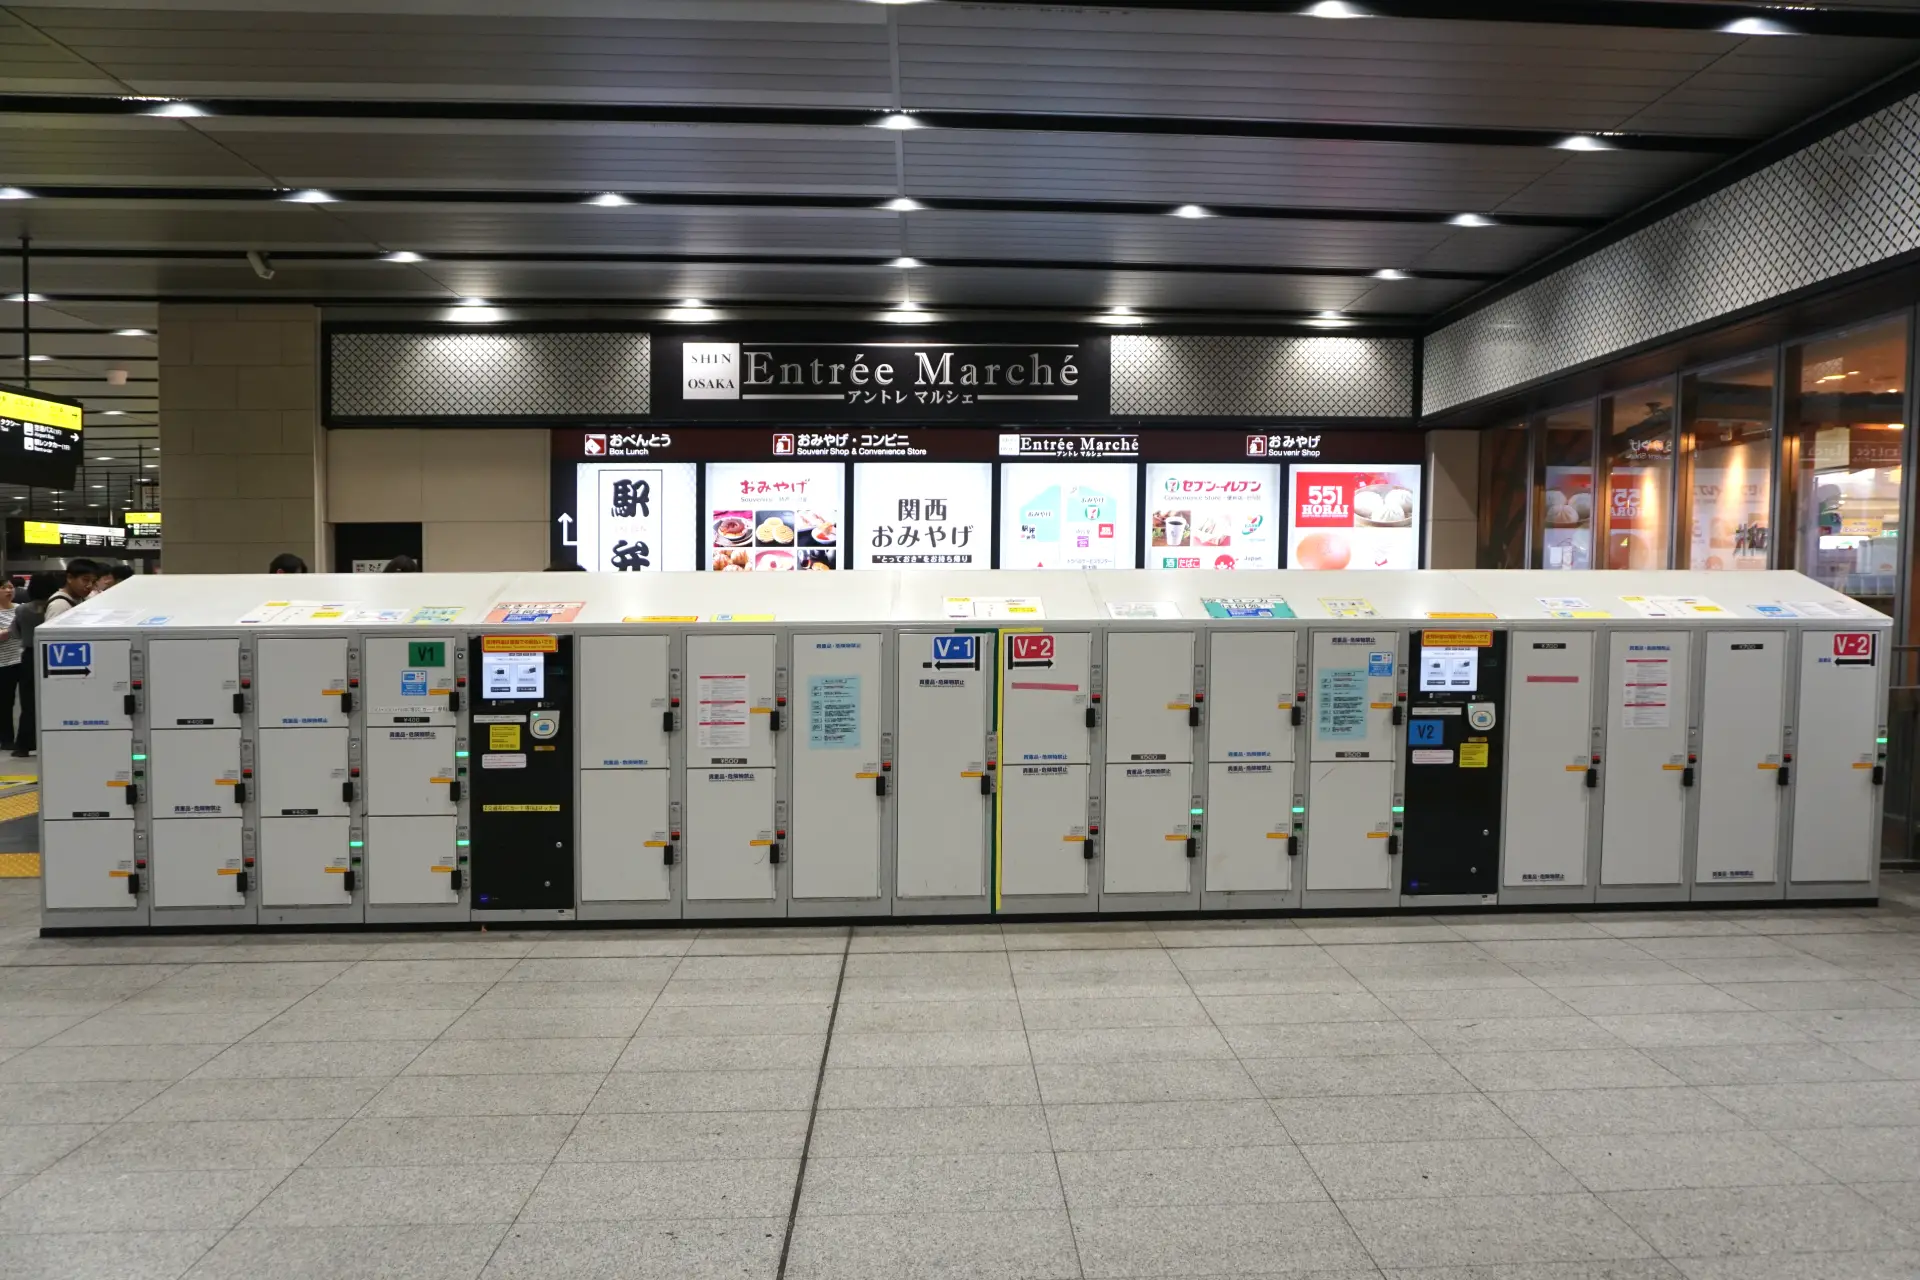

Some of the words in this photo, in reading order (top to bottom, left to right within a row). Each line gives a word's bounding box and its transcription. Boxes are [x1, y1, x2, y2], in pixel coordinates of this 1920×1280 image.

[690, 353, 731, 364] SHIN
[743, 351, 894, 386] Entrée
[914, 351, 1079, 386] Marché
[688, 378, 735, 389] OSAKA
[847, 389, 908, 404] アントレ
[914, 389, 974, 404] マルシェ
[609, 433, 672, 447] おべんとう
[1020, 437, 1074, 450] Entrée
[1080, 437, 1139, 450] Marché
[1269, 434, 1322, 448] おみやげ
[609, 447, 625, 455] Box
[625, 447, 649, 455] Lunch
[797, 447, 829, 455] Souvenir
[830, 447, 850, 456] Shop
[859, 447, 906, 455] Convenience
[907, 447, 927, 455] Store
[1268, 448, 1300, 456] Souvenir
[1301, 448, 1321, 457] Shop
[740, 478, 811, 495] おみやげ
[1308, 485, 1343, 505] 551
[898, 498, 948, 521] 関西
[1301, 504, 1349, 515] HORAI
[872, 524, 974, 548] おみやげ
[1178, 558, 1200, 568] たばこ
[935, 639, 972, 657] V-1
[1016, 638, 1051, 657] V-2
[1836, 636, 1868, 654] V-2
[53, 645, 87, 664] V-1
[417, 646, 435, 662] V1
[1416, 725, 1435, 739] V2
